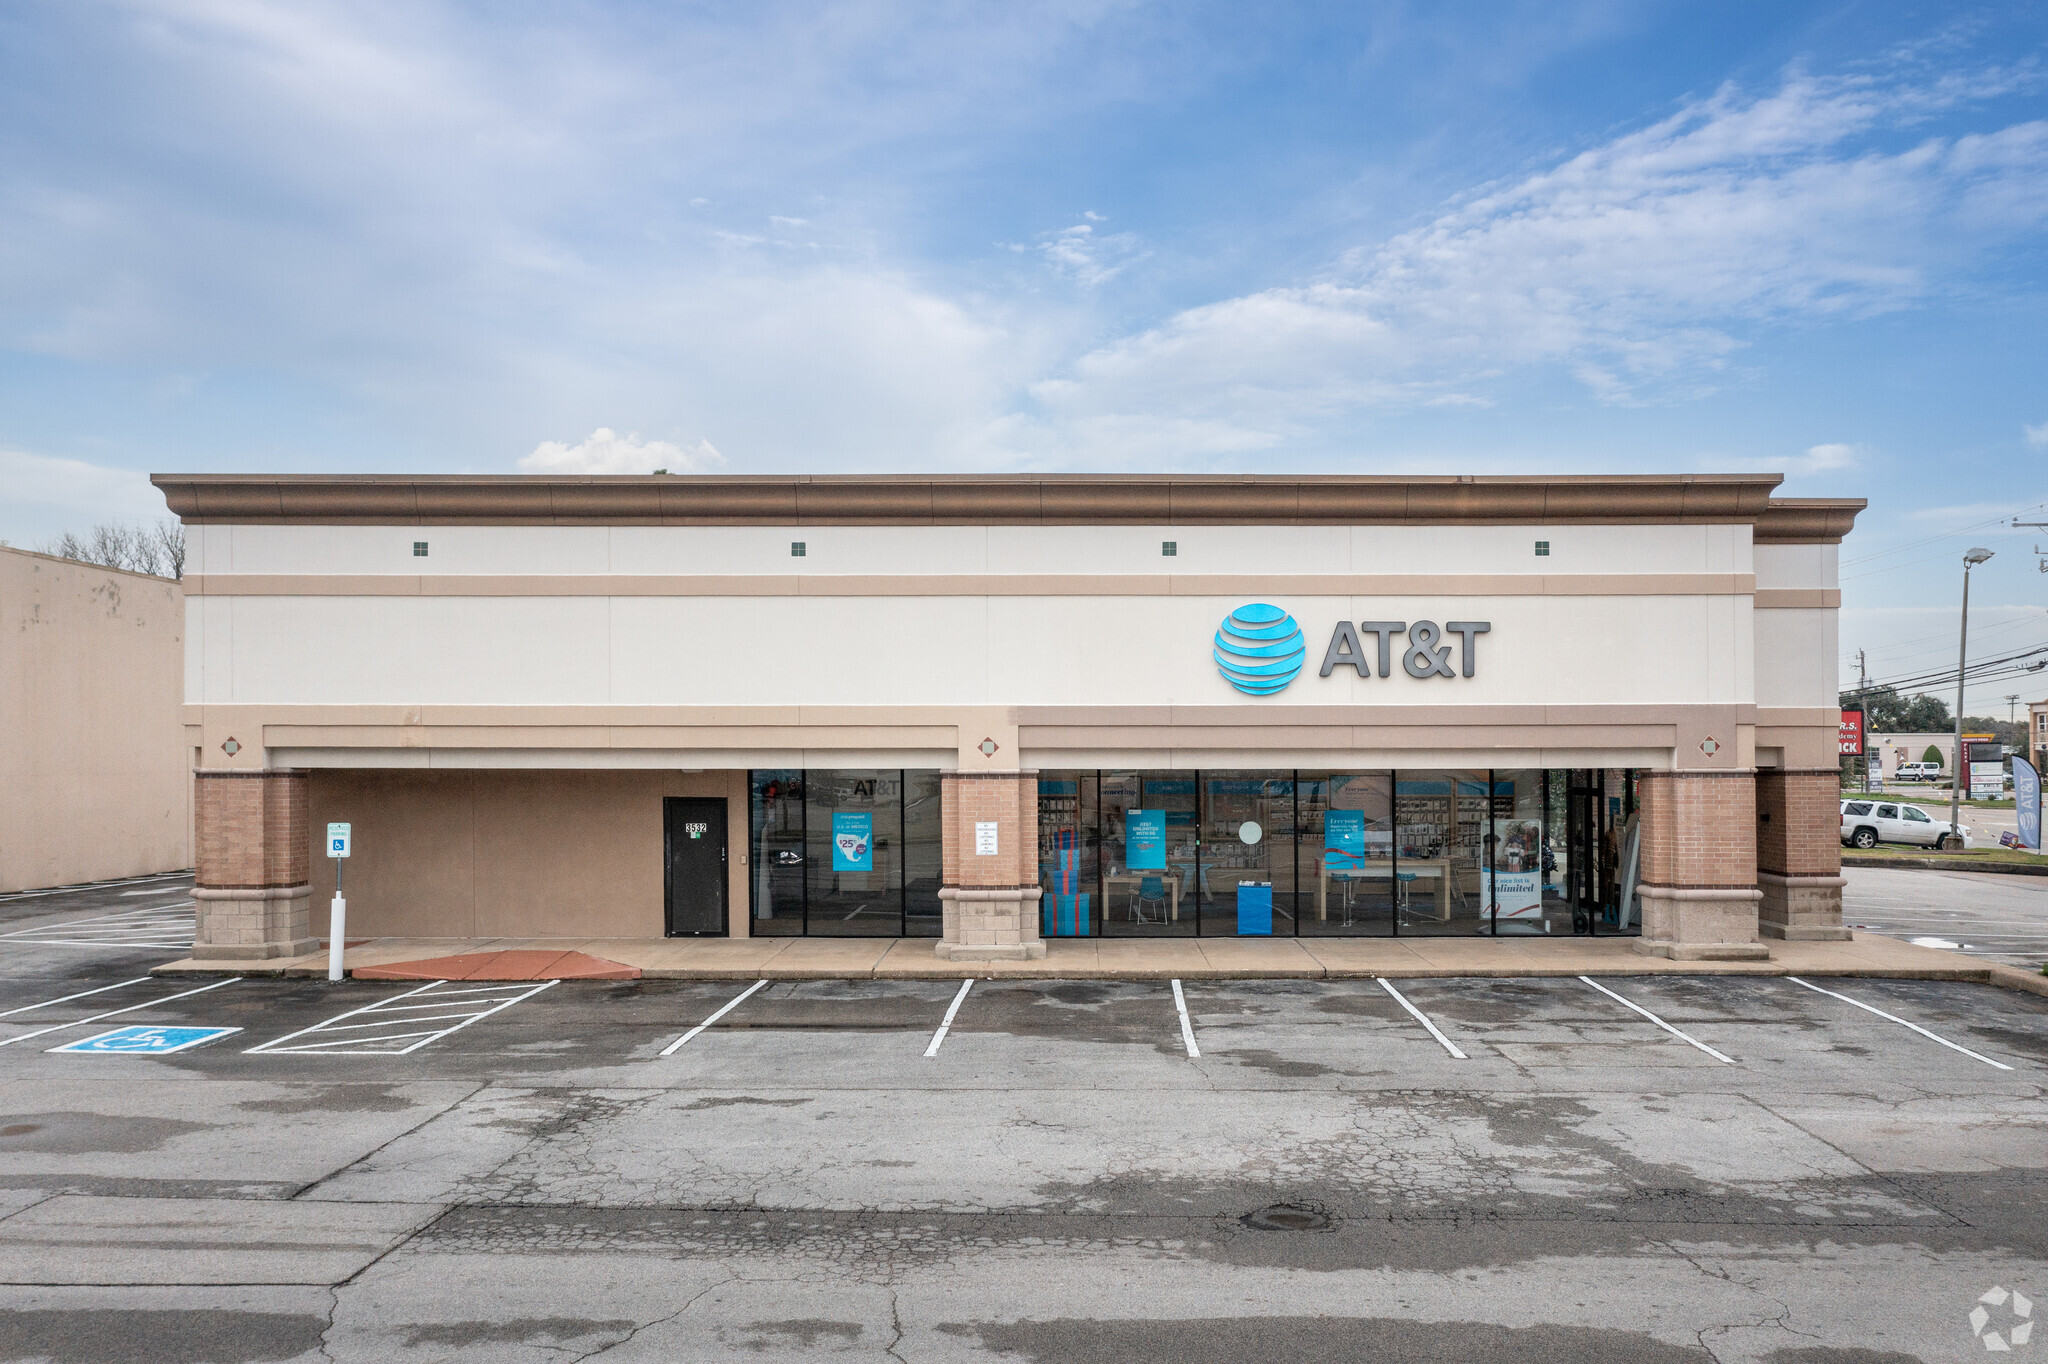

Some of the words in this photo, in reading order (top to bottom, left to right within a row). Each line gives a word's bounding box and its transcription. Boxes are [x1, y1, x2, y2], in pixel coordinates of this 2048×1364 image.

[1319, 620, 1491, 678] AT&T
[1839, 722, 1858, 730] R.S.
[1838, 742, 1858, 753] ICK
[854, 779, 901, 796] AT&T
[2020, 775, 2034, 809] AT&T
[686, 823, 706, 832] 3532
